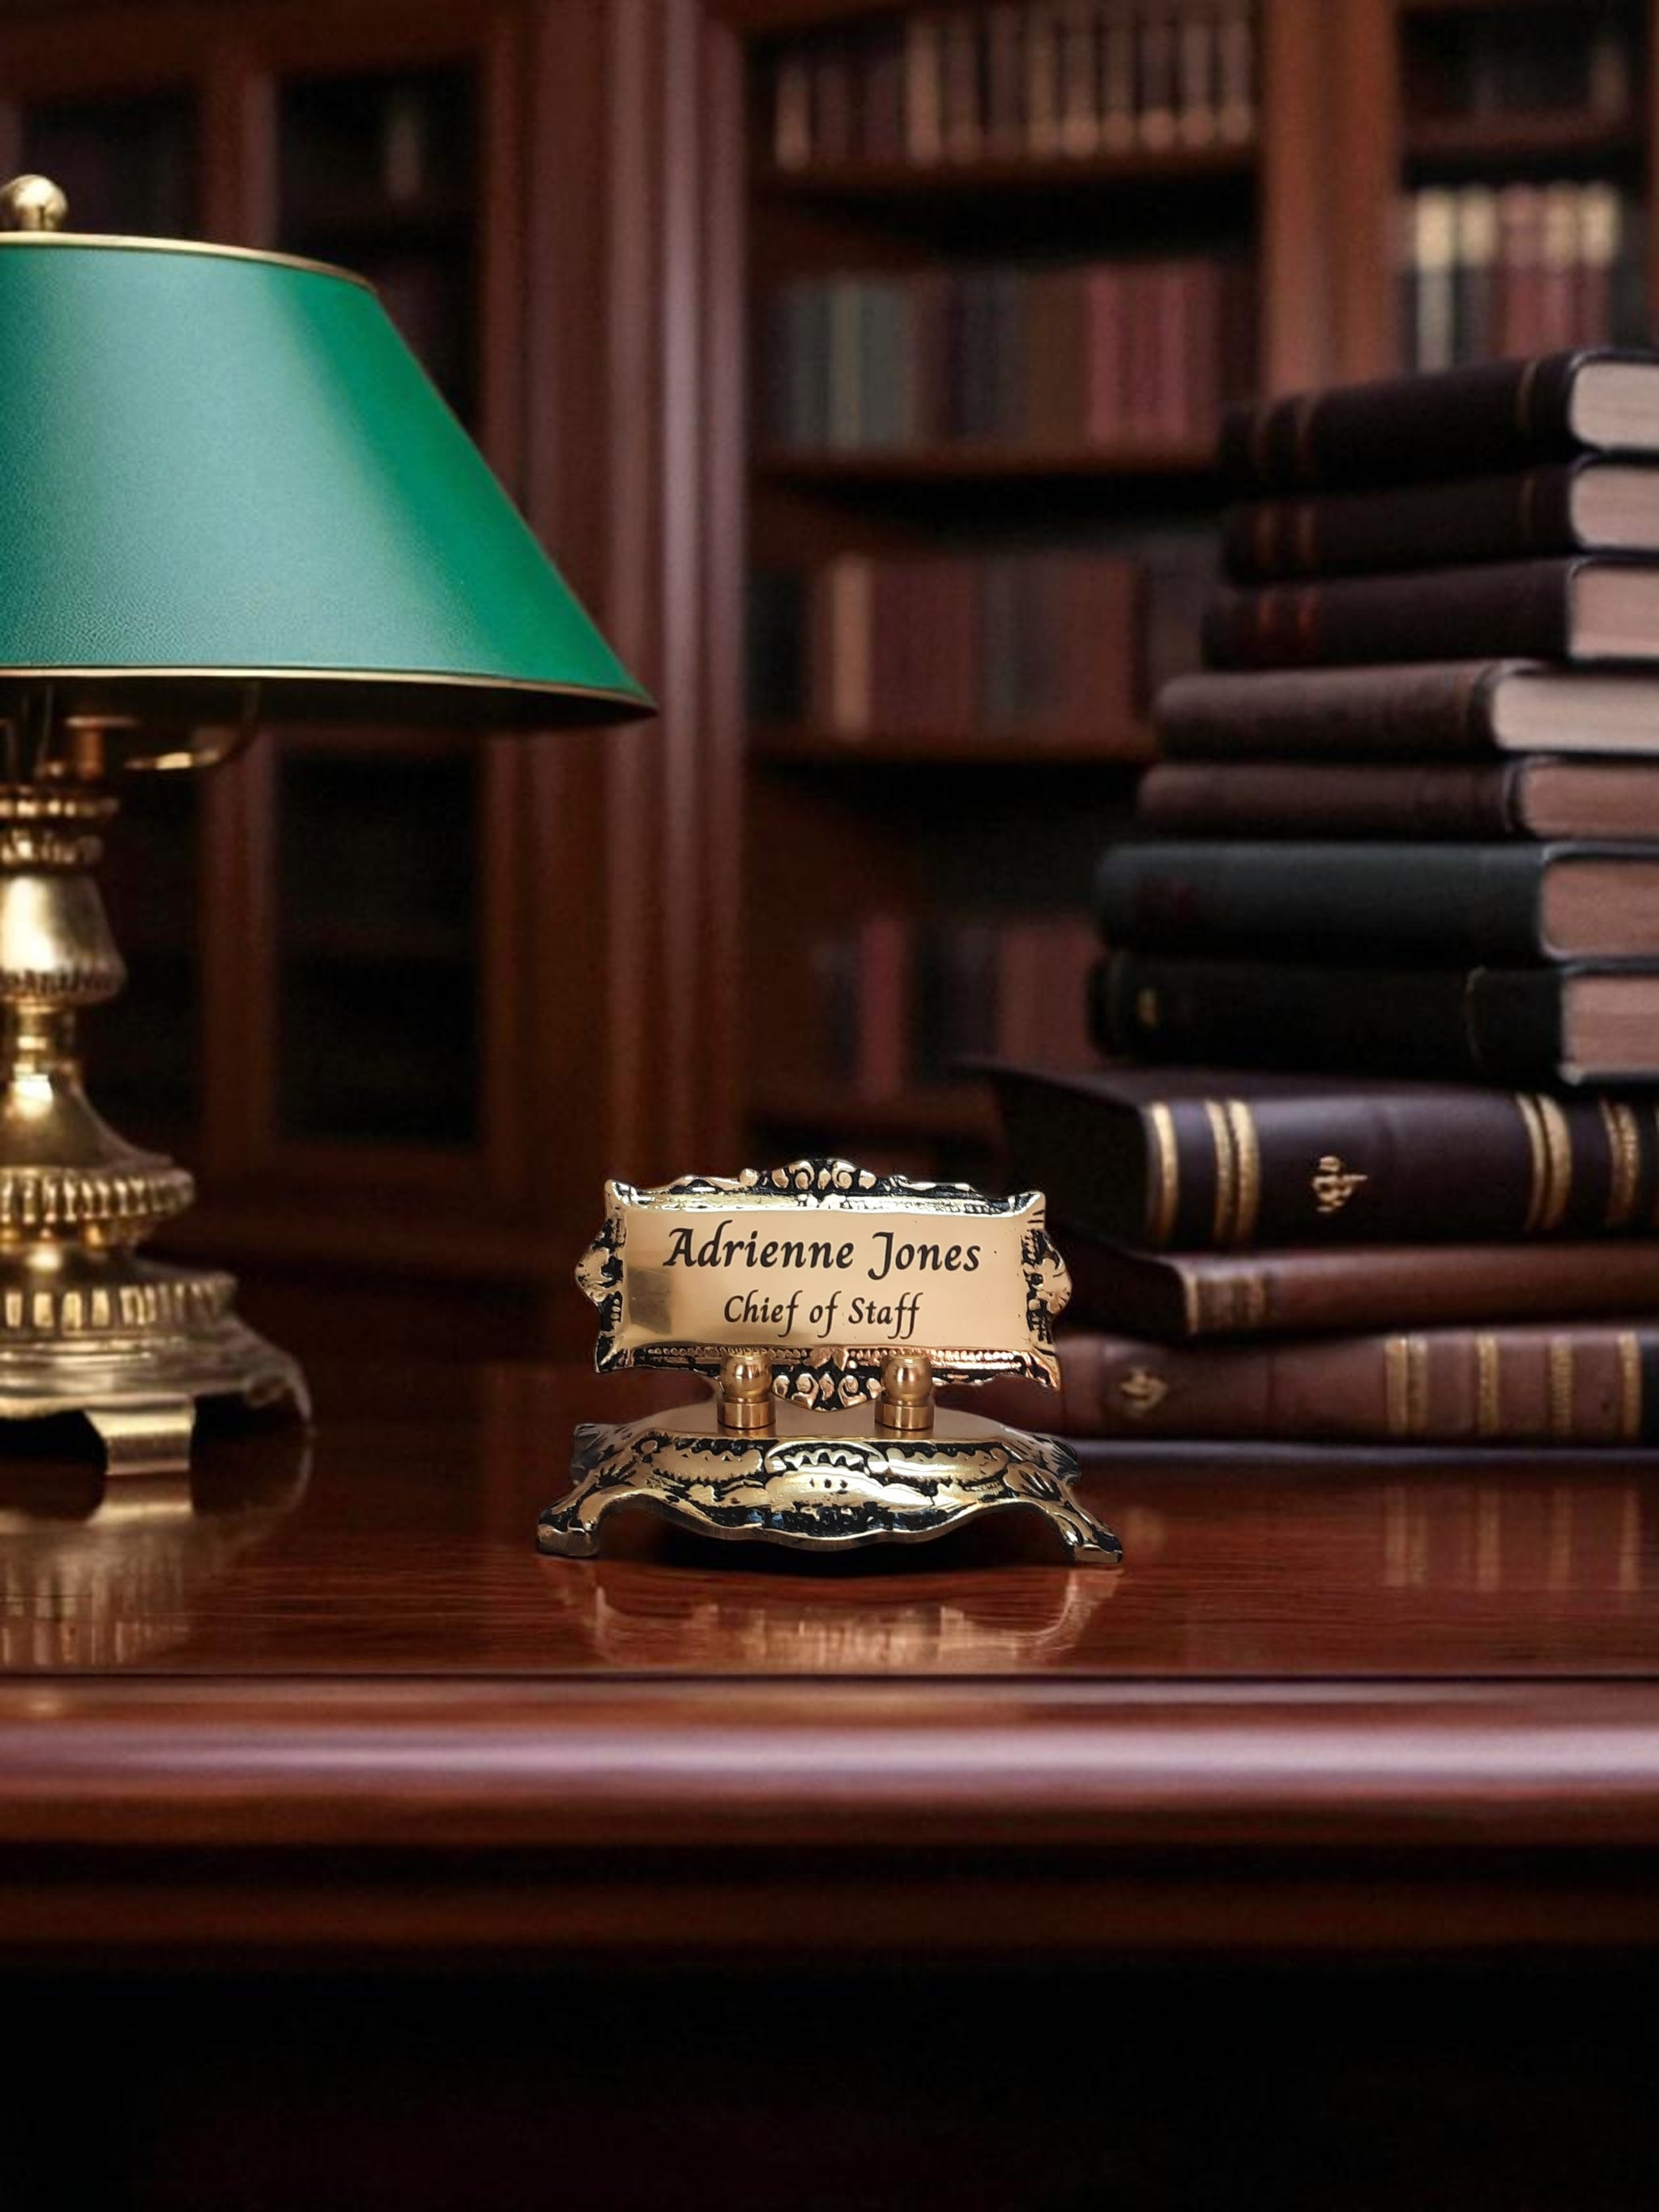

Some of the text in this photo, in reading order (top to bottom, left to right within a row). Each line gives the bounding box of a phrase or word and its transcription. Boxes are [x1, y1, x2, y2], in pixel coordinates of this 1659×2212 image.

[663, 1220, 981, 1281] Adrienne Jones
[723, 1289, 923, 1340] Chief of Staff
